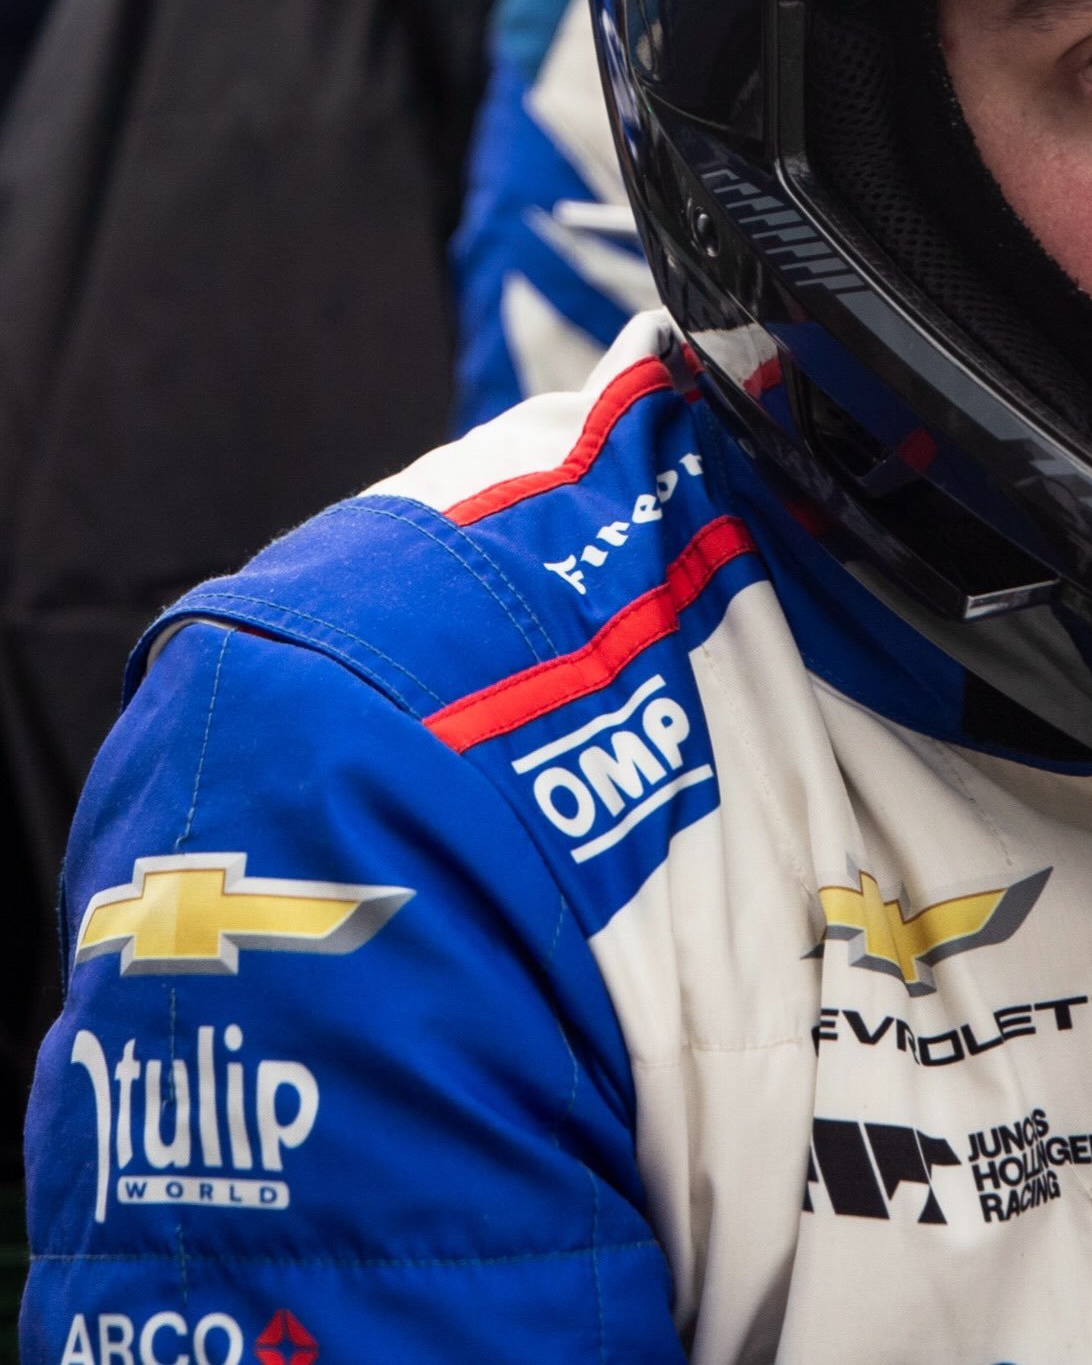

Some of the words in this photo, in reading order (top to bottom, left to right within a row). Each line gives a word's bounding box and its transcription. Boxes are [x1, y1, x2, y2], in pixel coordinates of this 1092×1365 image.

[533, 697, 690, 837] OMP
[811, 996, 1088, 1066] EVROLET
[116, 1024, 319, 1172] tulip
[125, 1180, 279, 1205] WORLD
[979, 1170, 1061, 1222] RACING
[60, 1312, 244, 1365] ARCO
